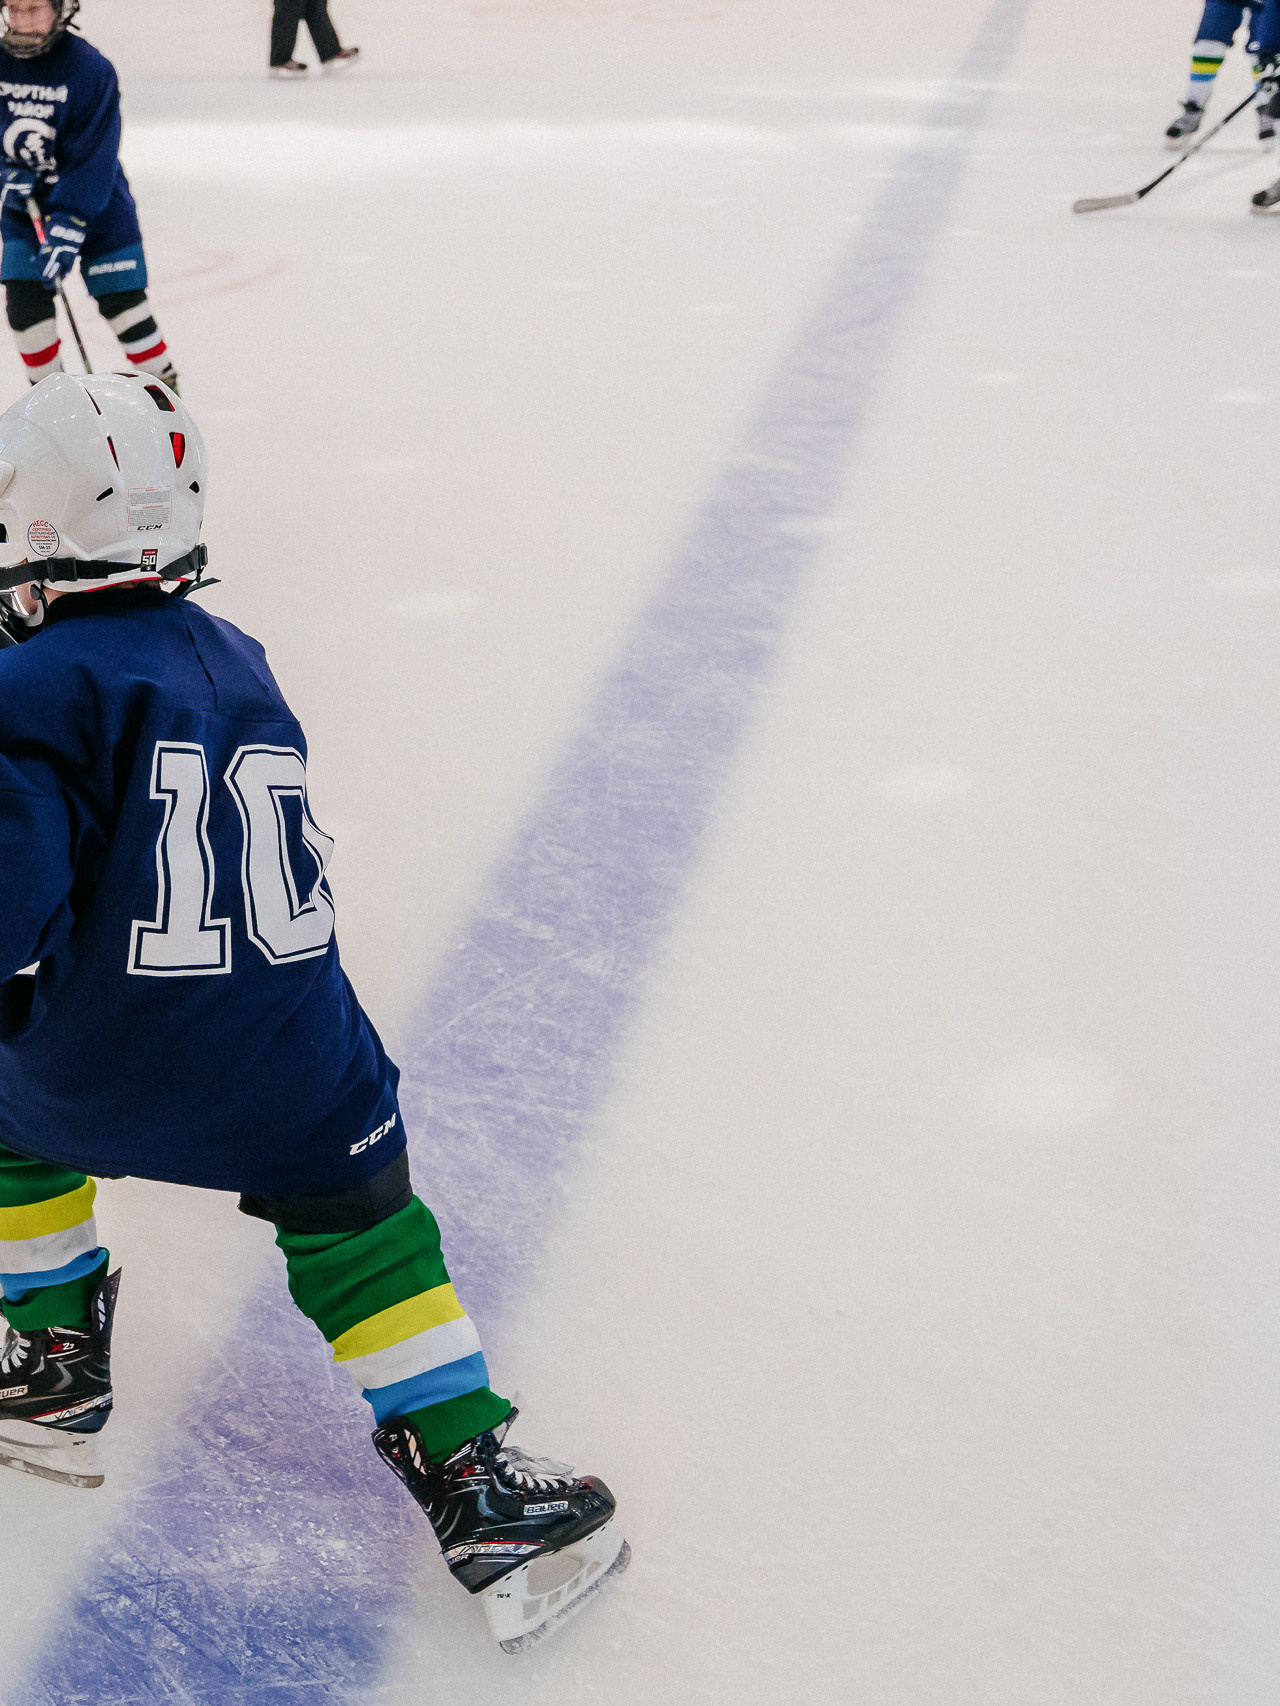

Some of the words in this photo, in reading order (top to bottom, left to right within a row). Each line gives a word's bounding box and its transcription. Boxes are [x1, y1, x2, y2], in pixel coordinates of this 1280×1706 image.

[142, 555, 157, 565] 50
[126, 740, 335, 978] 10
[349, 1112, 396, 1156] CCM
